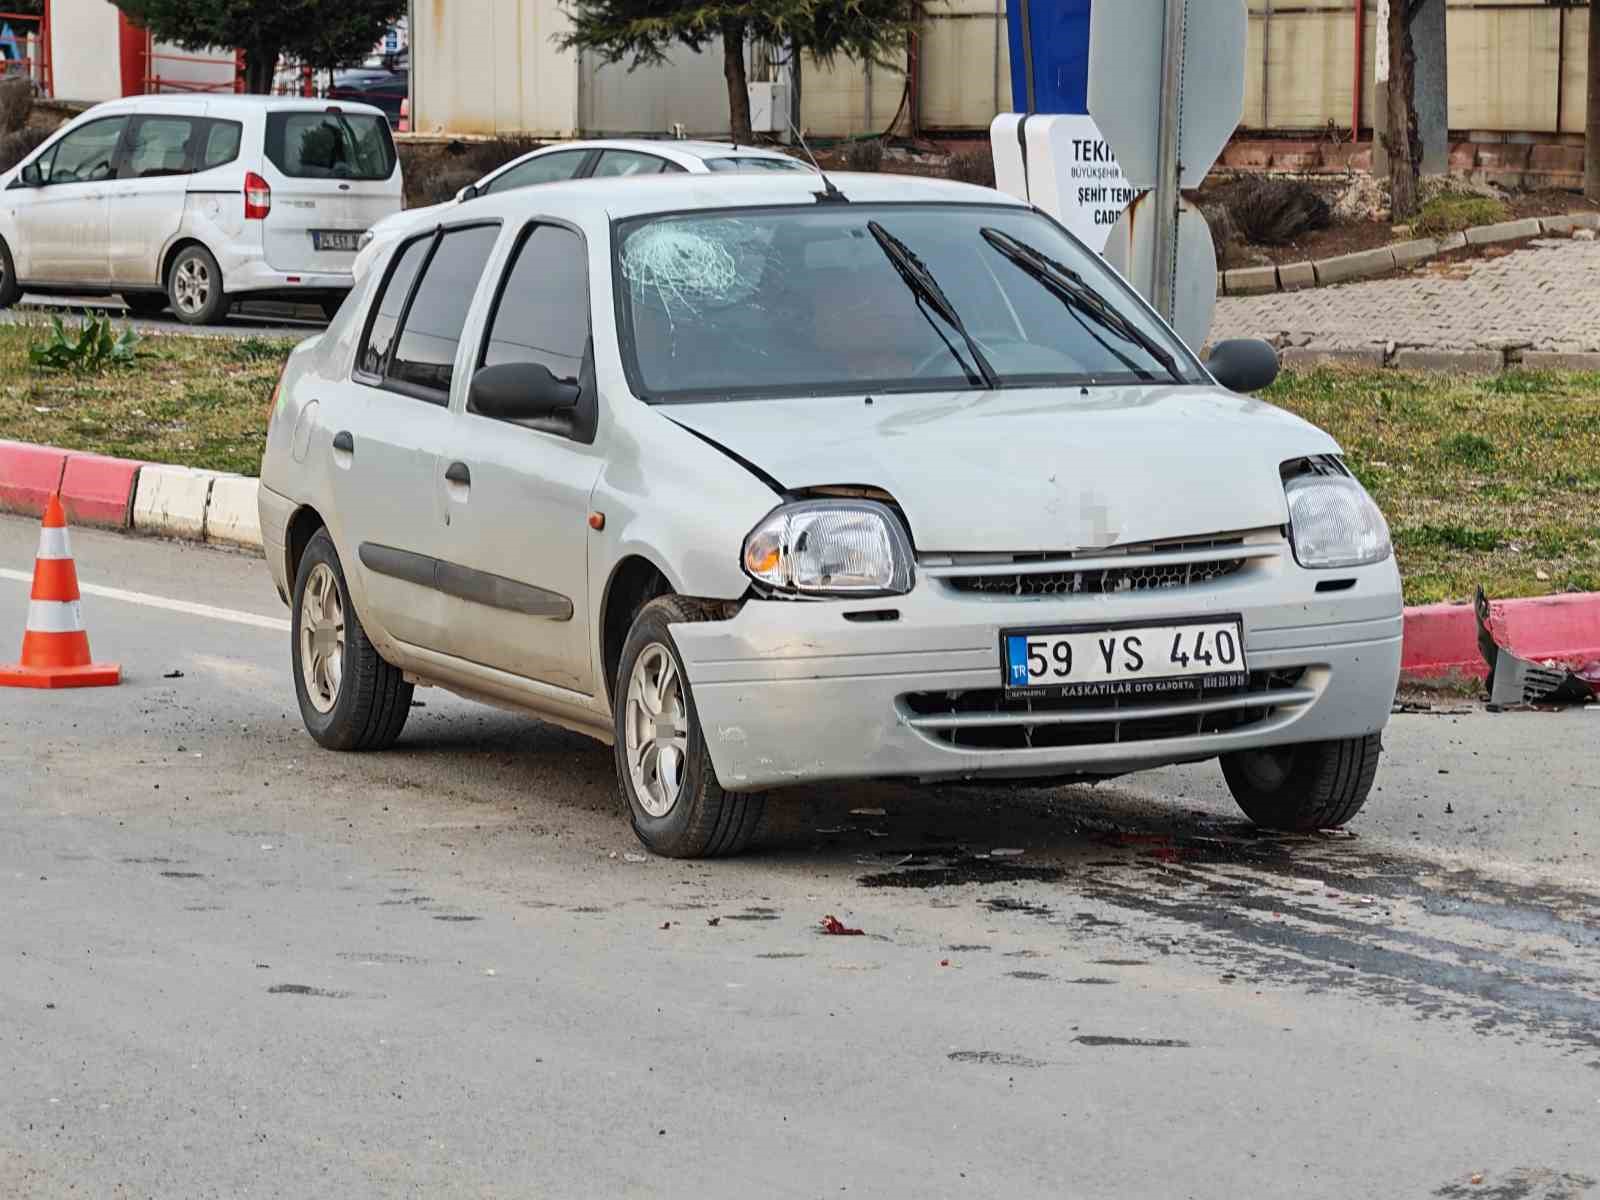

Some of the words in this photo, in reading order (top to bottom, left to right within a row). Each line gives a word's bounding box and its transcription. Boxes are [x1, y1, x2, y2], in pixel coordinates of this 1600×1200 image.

[1078, 184, 1108, 207] ŞEHİT
[1027, 640, 1073, 678] 59
[1099, 636, 1144, 674] YS
[1170, 629, 1236, 668] 440
[1012, 664, 1027, 678] TR
[1135, 683, 1154, 693] OTO
